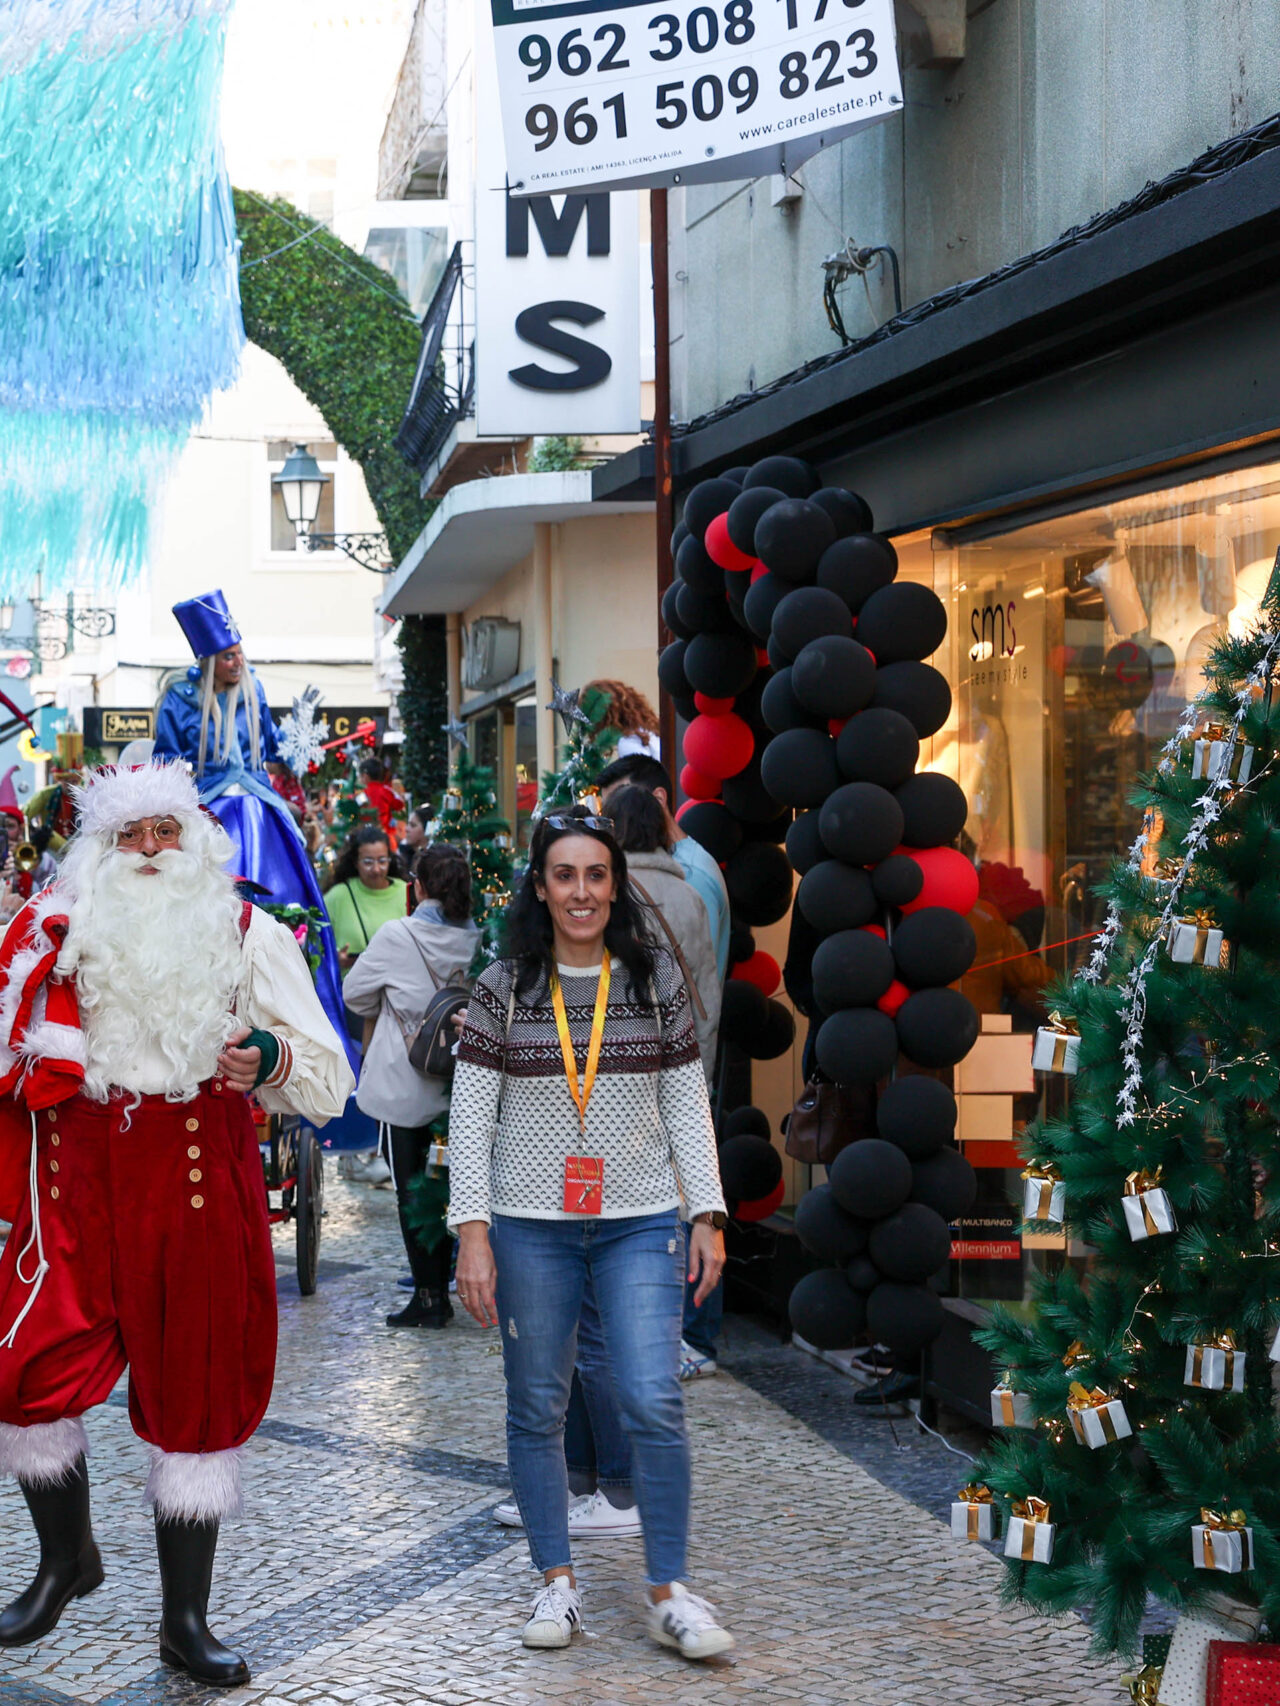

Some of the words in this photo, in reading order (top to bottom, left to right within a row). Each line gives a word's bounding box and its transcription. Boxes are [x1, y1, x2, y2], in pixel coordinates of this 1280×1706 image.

[518, 23, 630, 83] 962
[646, 0, 756, 62] 308
[524, 92, 628, 152] 961
[655, 65, 759, 130] 509
[779, 27, 879, 100] 823
[738, 90, 884, 140] www.carealestate.pt
[541, 171, 559, 179] REAL
[560, 167, 585, 176] ESTATE
[590, 163, 604, 172] AMI
[971, 601, 1017, 662] sms
[962, 1218, 1013, 1226] MULTIBANCO
[951, 1242, 1012, 1254] Millennium
